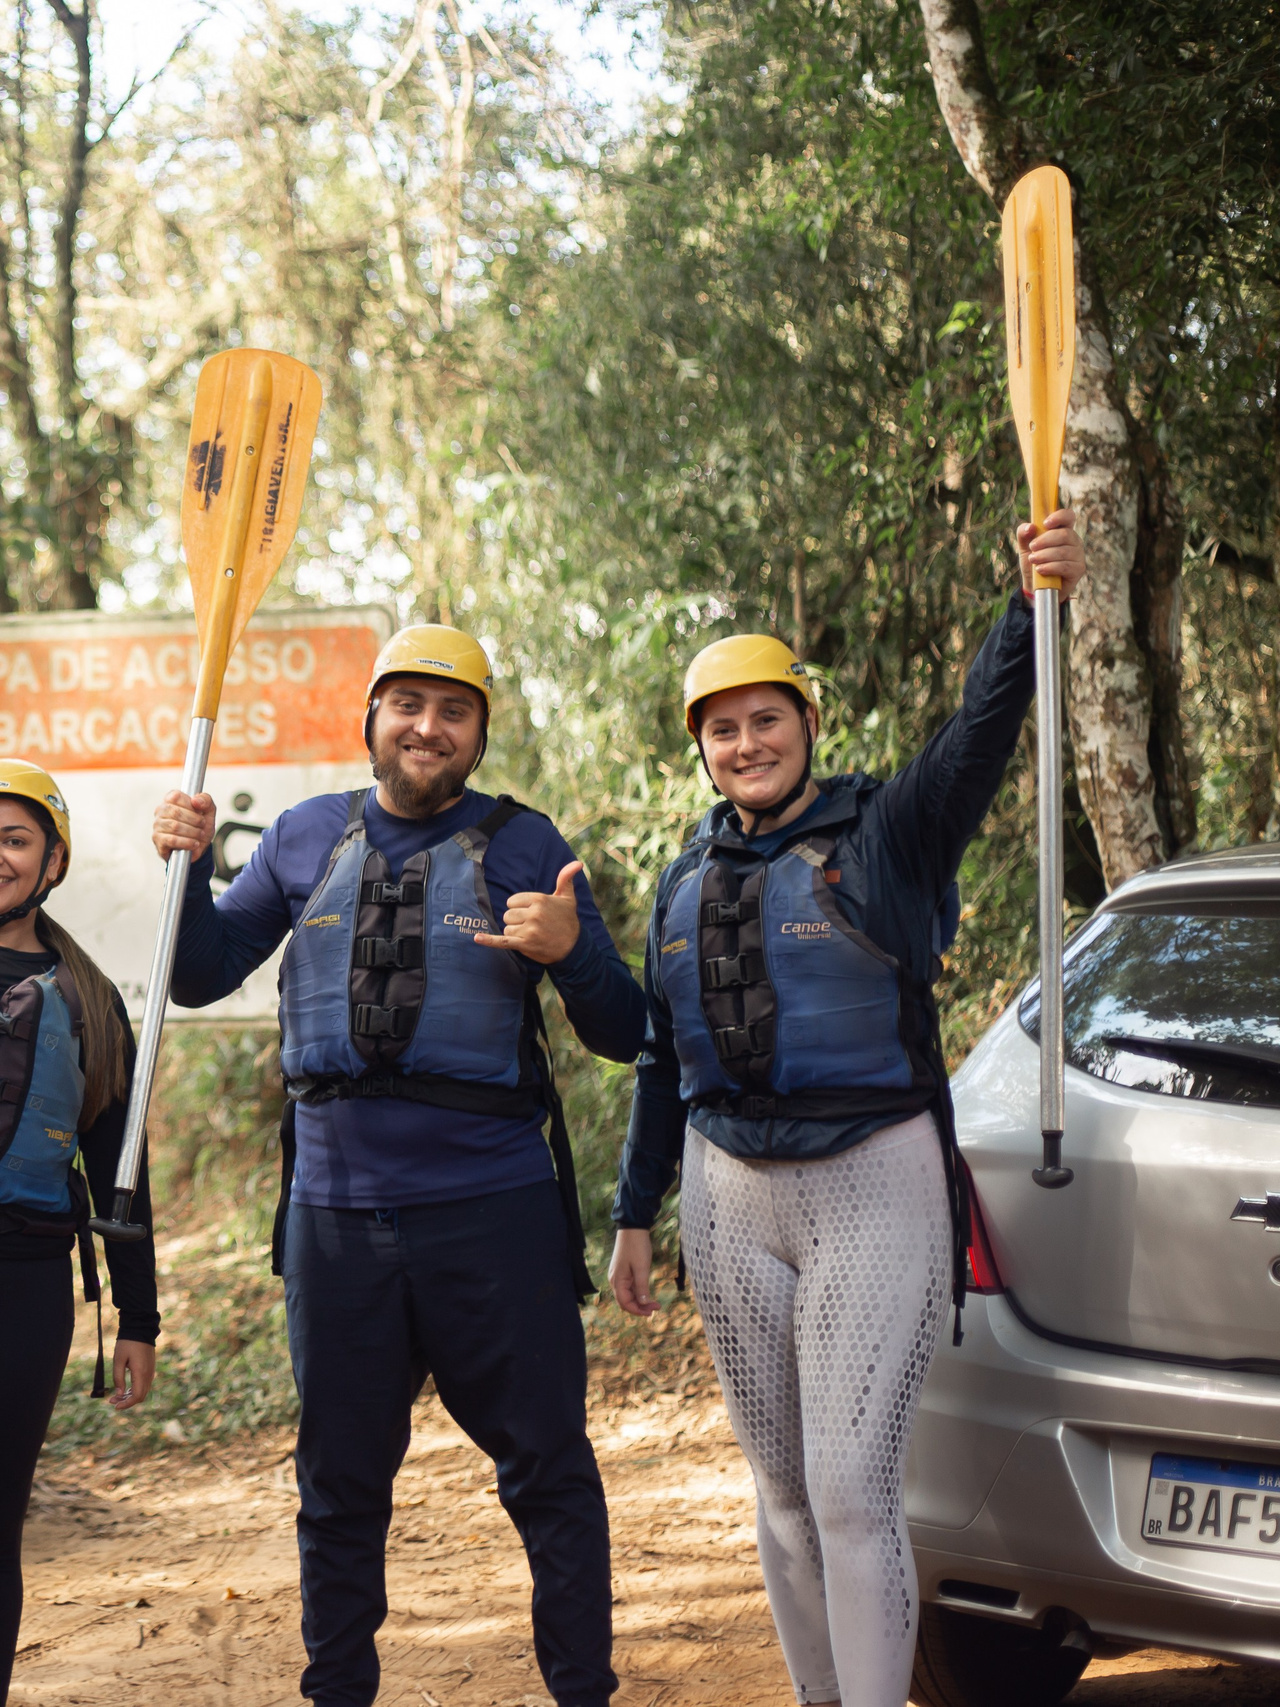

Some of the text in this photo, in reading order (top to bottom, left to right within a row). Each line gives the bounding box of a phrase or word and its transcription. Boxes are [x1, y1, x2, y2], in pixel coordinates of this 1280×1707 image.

[49, 647, 112, 692] DE
[443, 913, 489, 930] Canoe
[781, 921, 831, 934] Canoe
[797, 932, 831, 940] Universal
[1168, 1485, 1280, 1543] BAF5
[1148, 1518, 1162, 1534] BR
